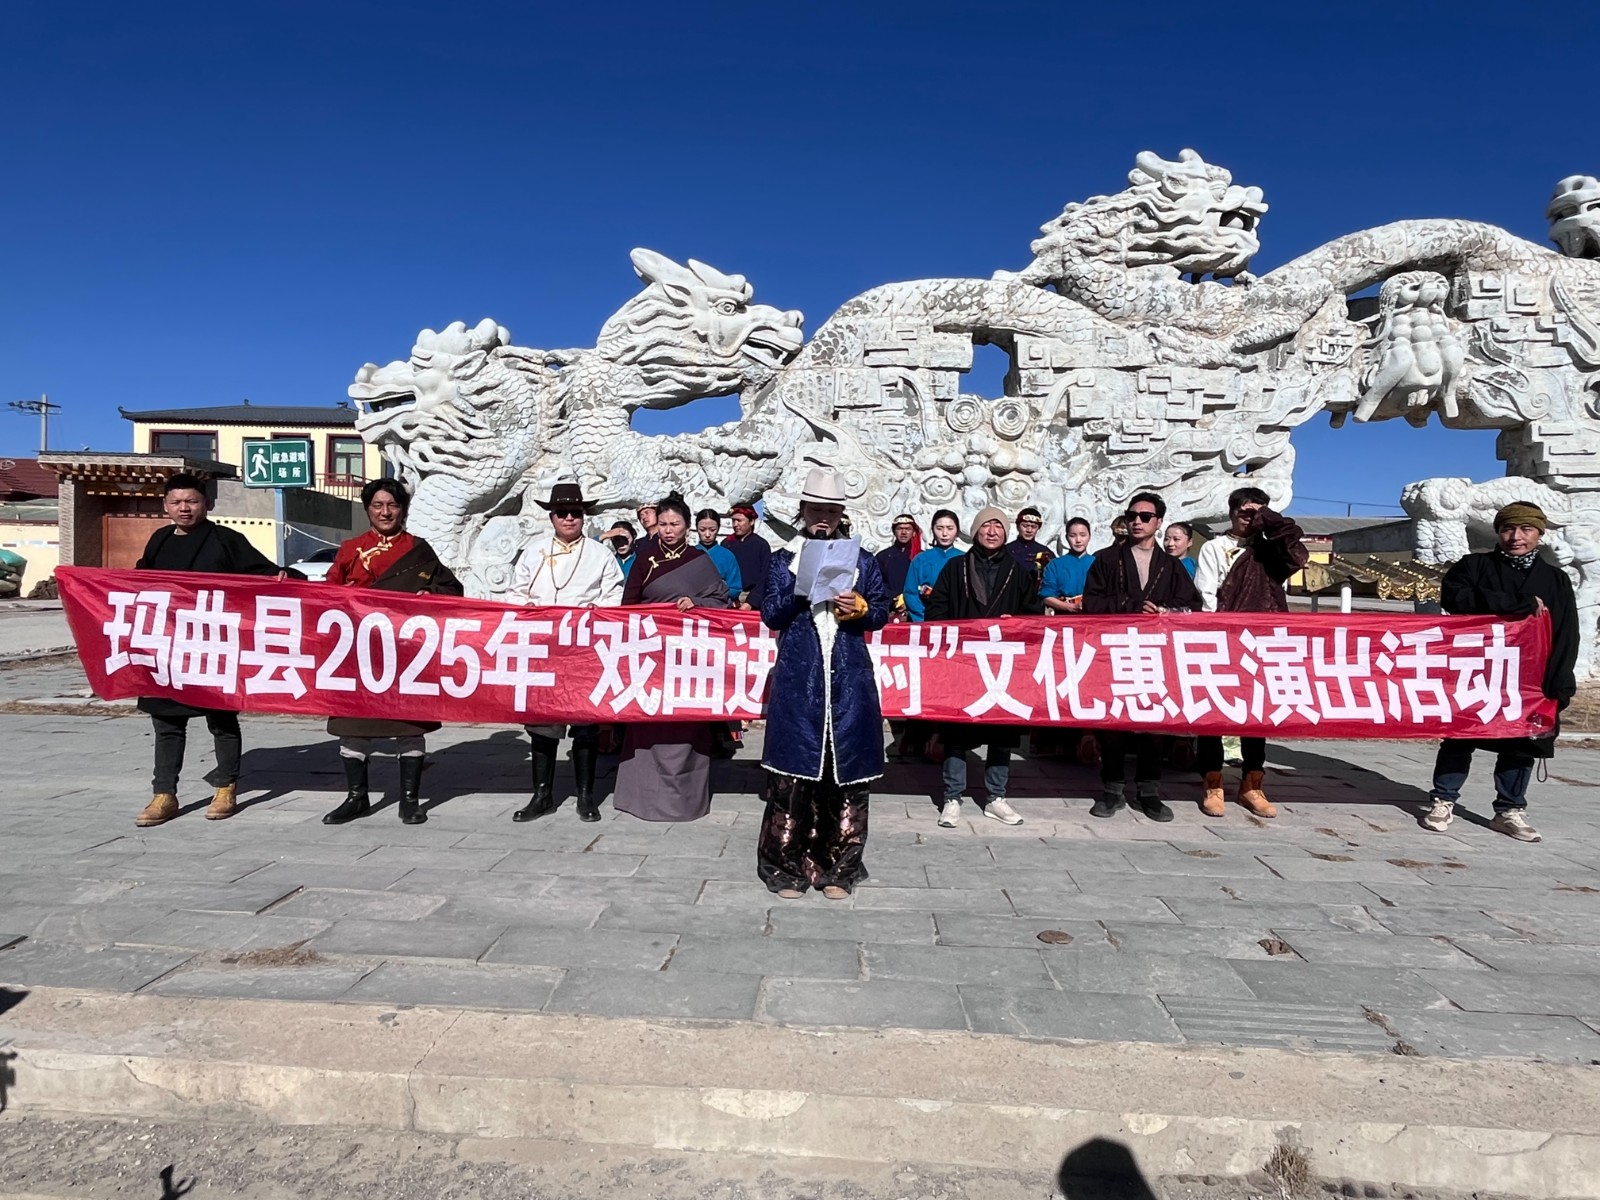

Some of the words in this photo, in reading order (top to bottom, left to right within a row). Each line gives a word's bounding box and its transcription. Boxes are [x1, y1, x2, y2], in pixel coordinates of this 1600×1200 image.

[272, 452, 306, 463] 应急避难
[278, 467, 301, 478] 场所
[103, 589, 1522, 726] 玛曲县2025年“戏曲进村”文化惠民演出活动
